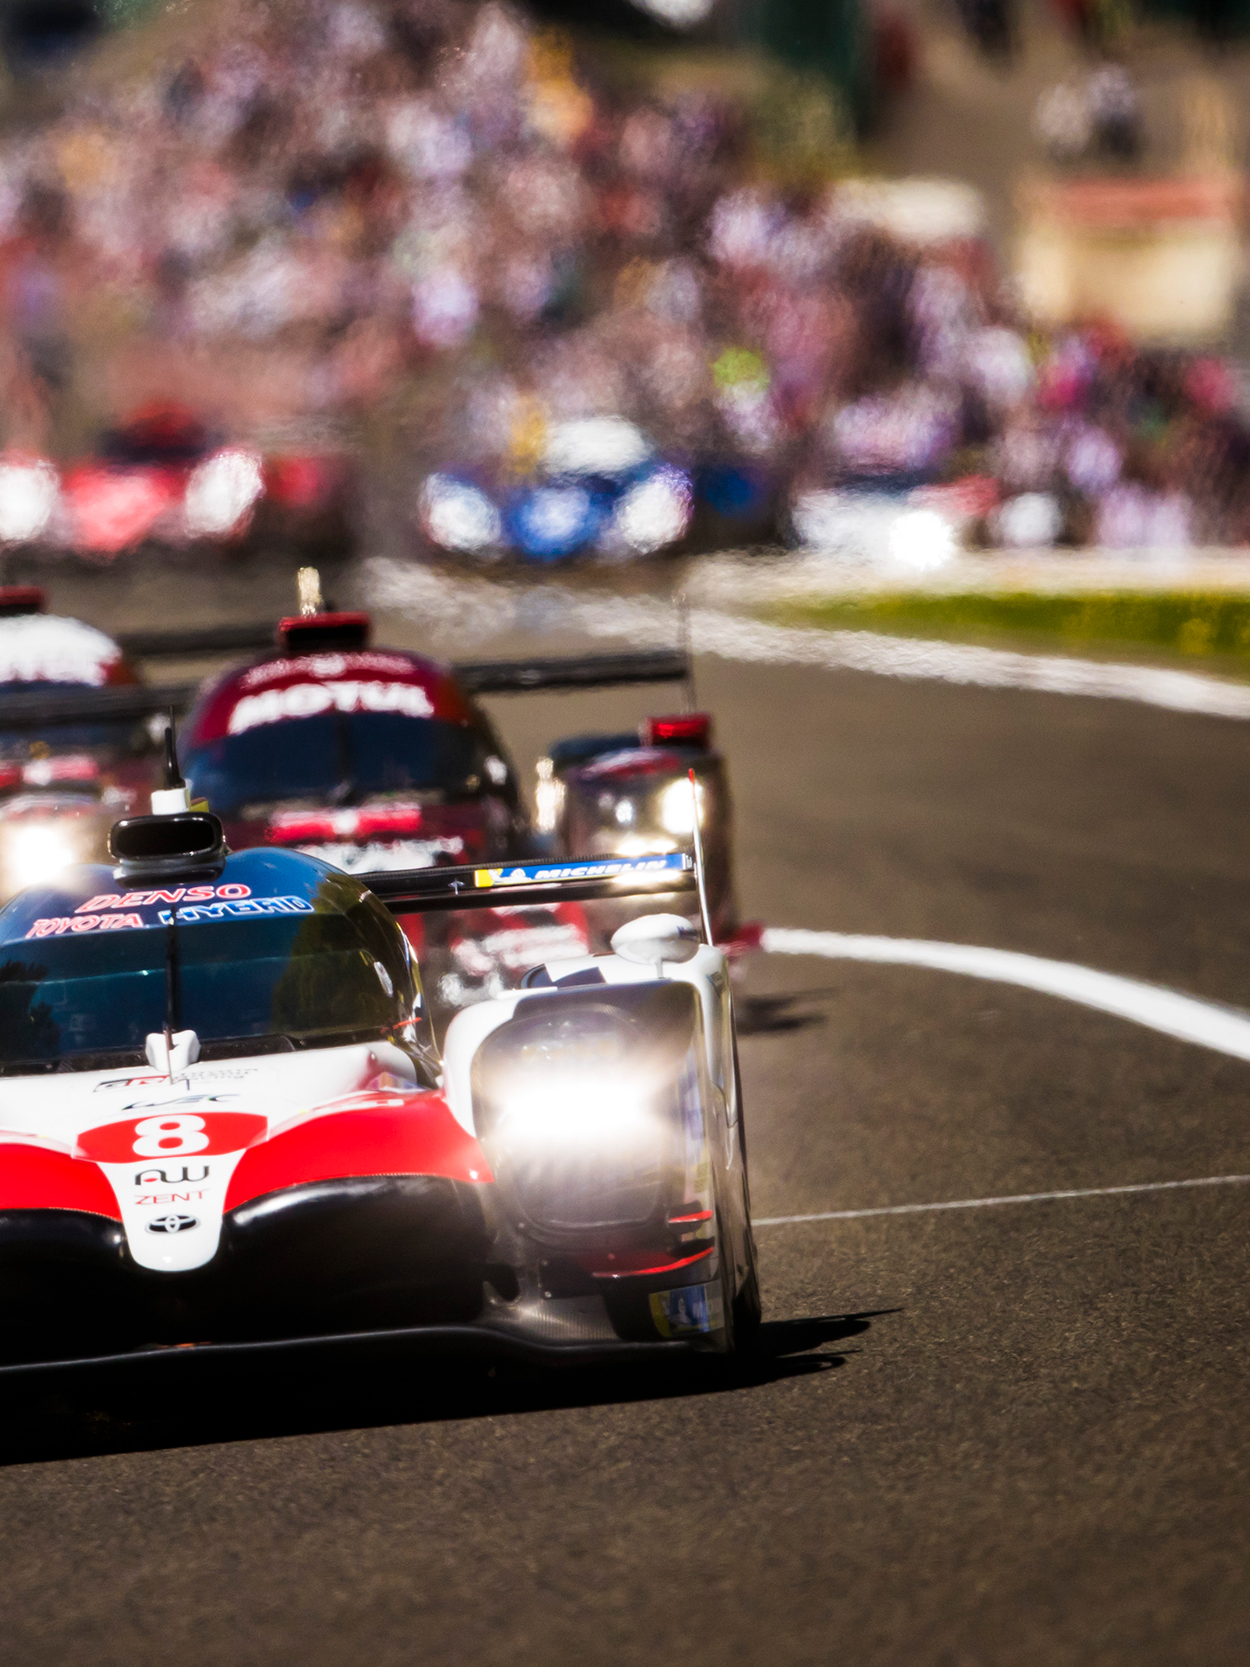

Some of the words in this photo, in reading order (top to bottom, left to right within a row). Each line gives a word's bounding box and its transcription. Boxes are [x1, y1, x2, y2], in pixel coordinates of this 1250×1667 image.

[535, 859, 667, 880] MICHELIN
[74, 883, 253, 914] DENSO
[25, 912, 145, 939] TOYOTA
[157, 895, 316, 925] HYBRID
[132, 1114, 210, 1158] 8
[134, 1188, 210, 1206] ZENT
